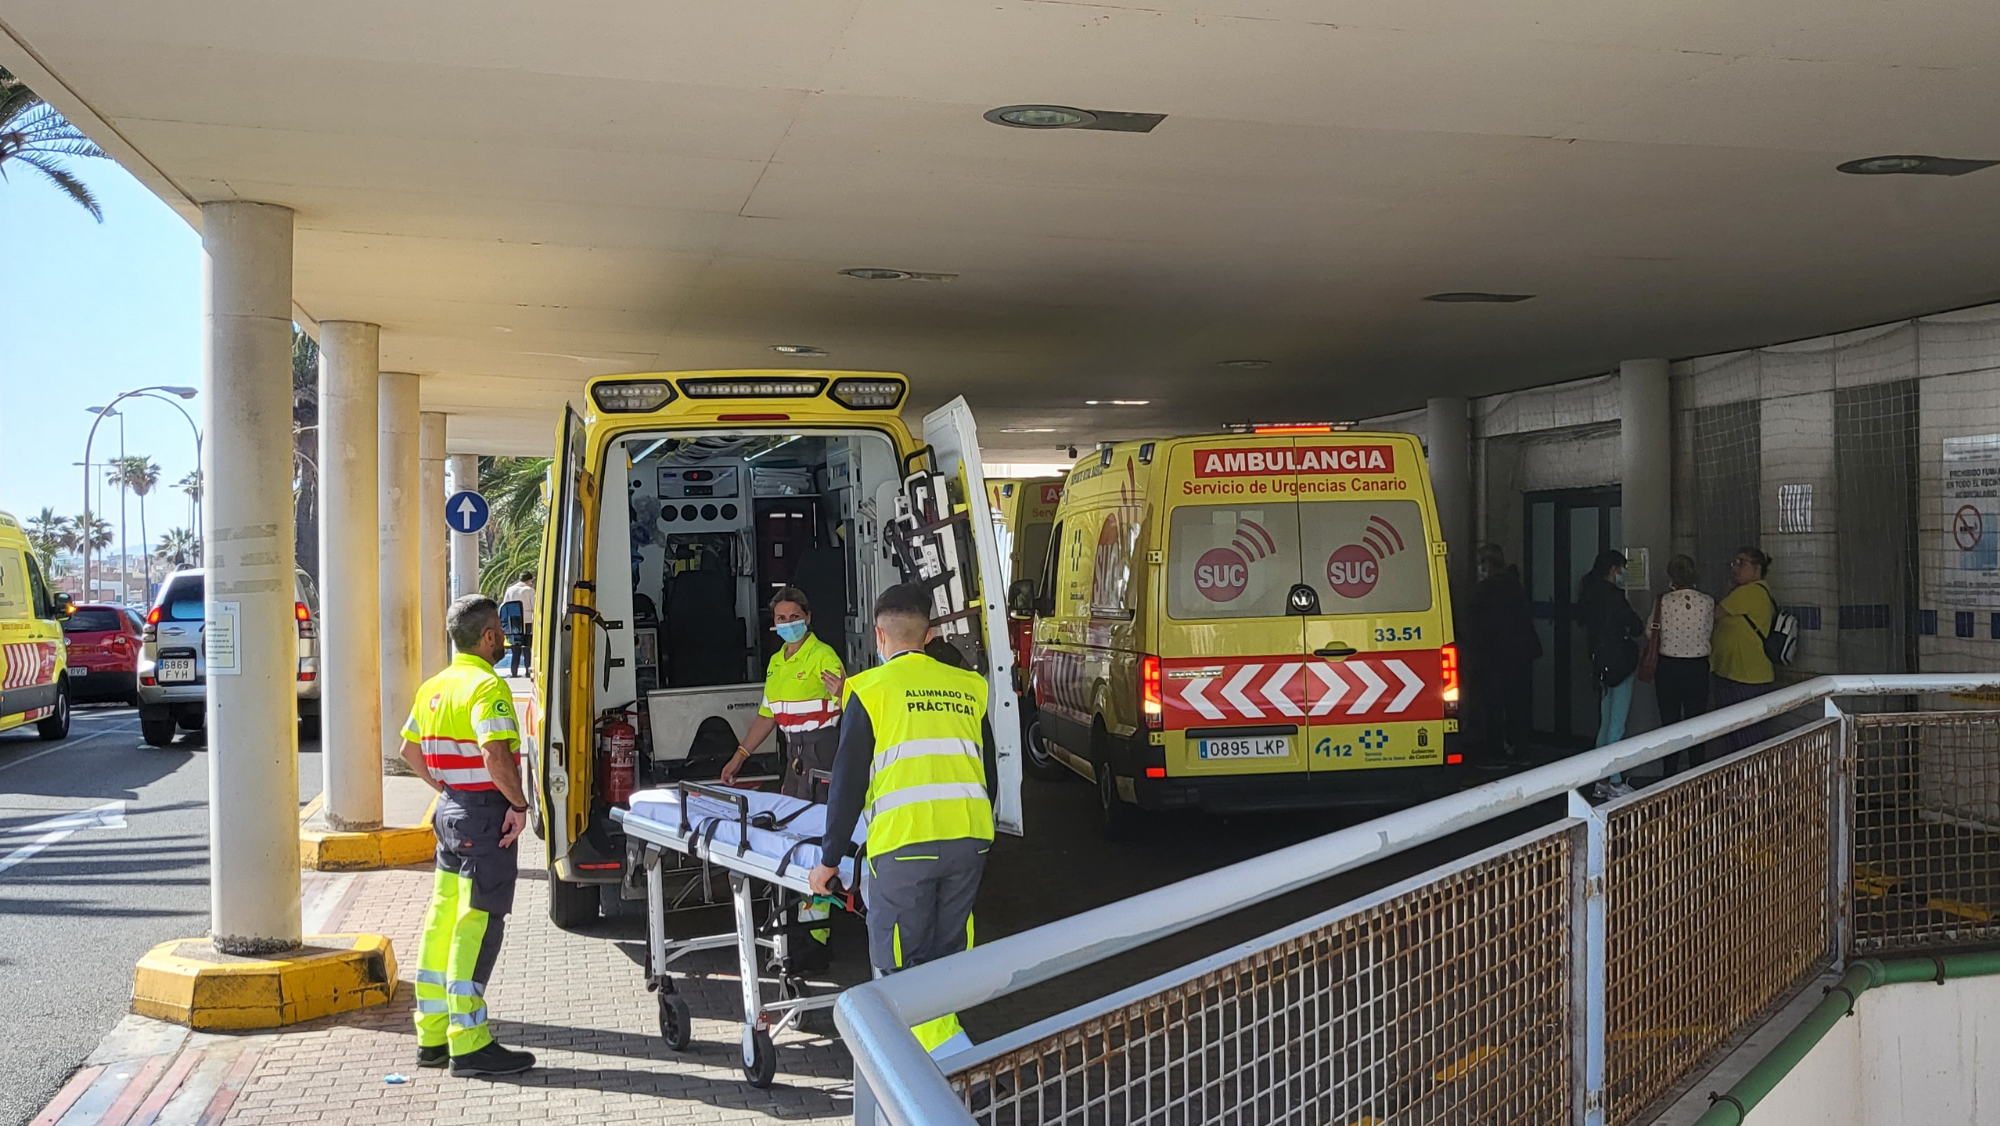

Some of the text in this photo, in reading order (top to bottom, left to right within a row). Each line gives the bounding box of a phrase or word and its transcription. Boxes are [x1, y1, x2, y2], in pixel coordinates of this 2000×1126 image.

[1204, 450, 1387, 473] AMBULANCIA
[1183, 477, 1407, 496] Servicio de Urgencias Canario
[1198, 564, 1245, 589] SUC
[1330, 560, 1376, 585] SUC
[1374, 626, 1422, 642] 33.51
[164, 660, 189, 670] 6869
[165, 670, 188, 679] FYH
[905, 689, 962, 699] ALUMNADO
[1210, 740, 1285, 757] 0895 LKP
[1322, 744, 1352, 758] 112
